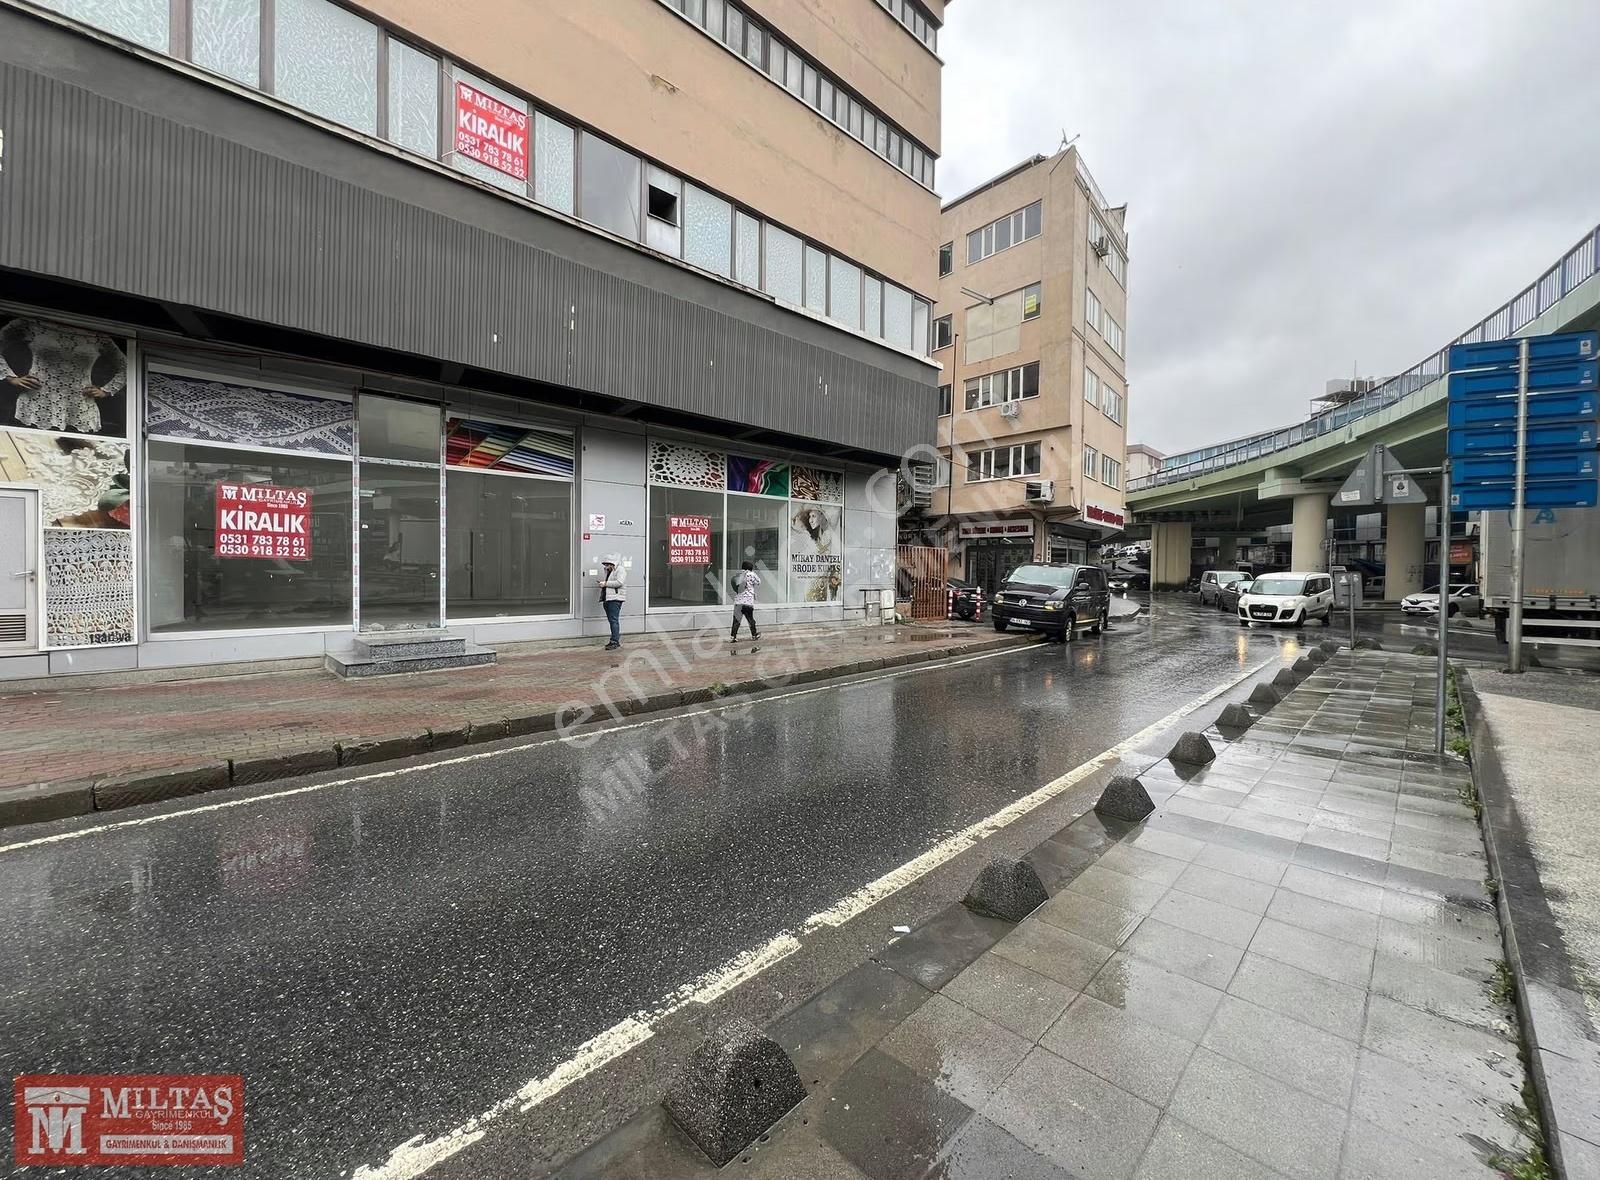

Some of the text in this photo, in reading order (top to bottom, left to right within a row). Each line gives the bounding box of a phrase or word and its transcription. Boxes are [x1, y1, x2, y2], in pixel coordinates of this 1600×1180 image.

[460, 108, 524, 155] KİRALIK
[458, 131, 524, 168] 0531 783 78 61
[458, 142, 525, 178] 0530 918 52 52
[221, 504, 305, 533] KİRALIK
[220, 534, 304, 547] 0531 783 78 61
[220, 544, 305, 556] 0530 918 52 52
[671, 529, 708, 547] KİRALIK
